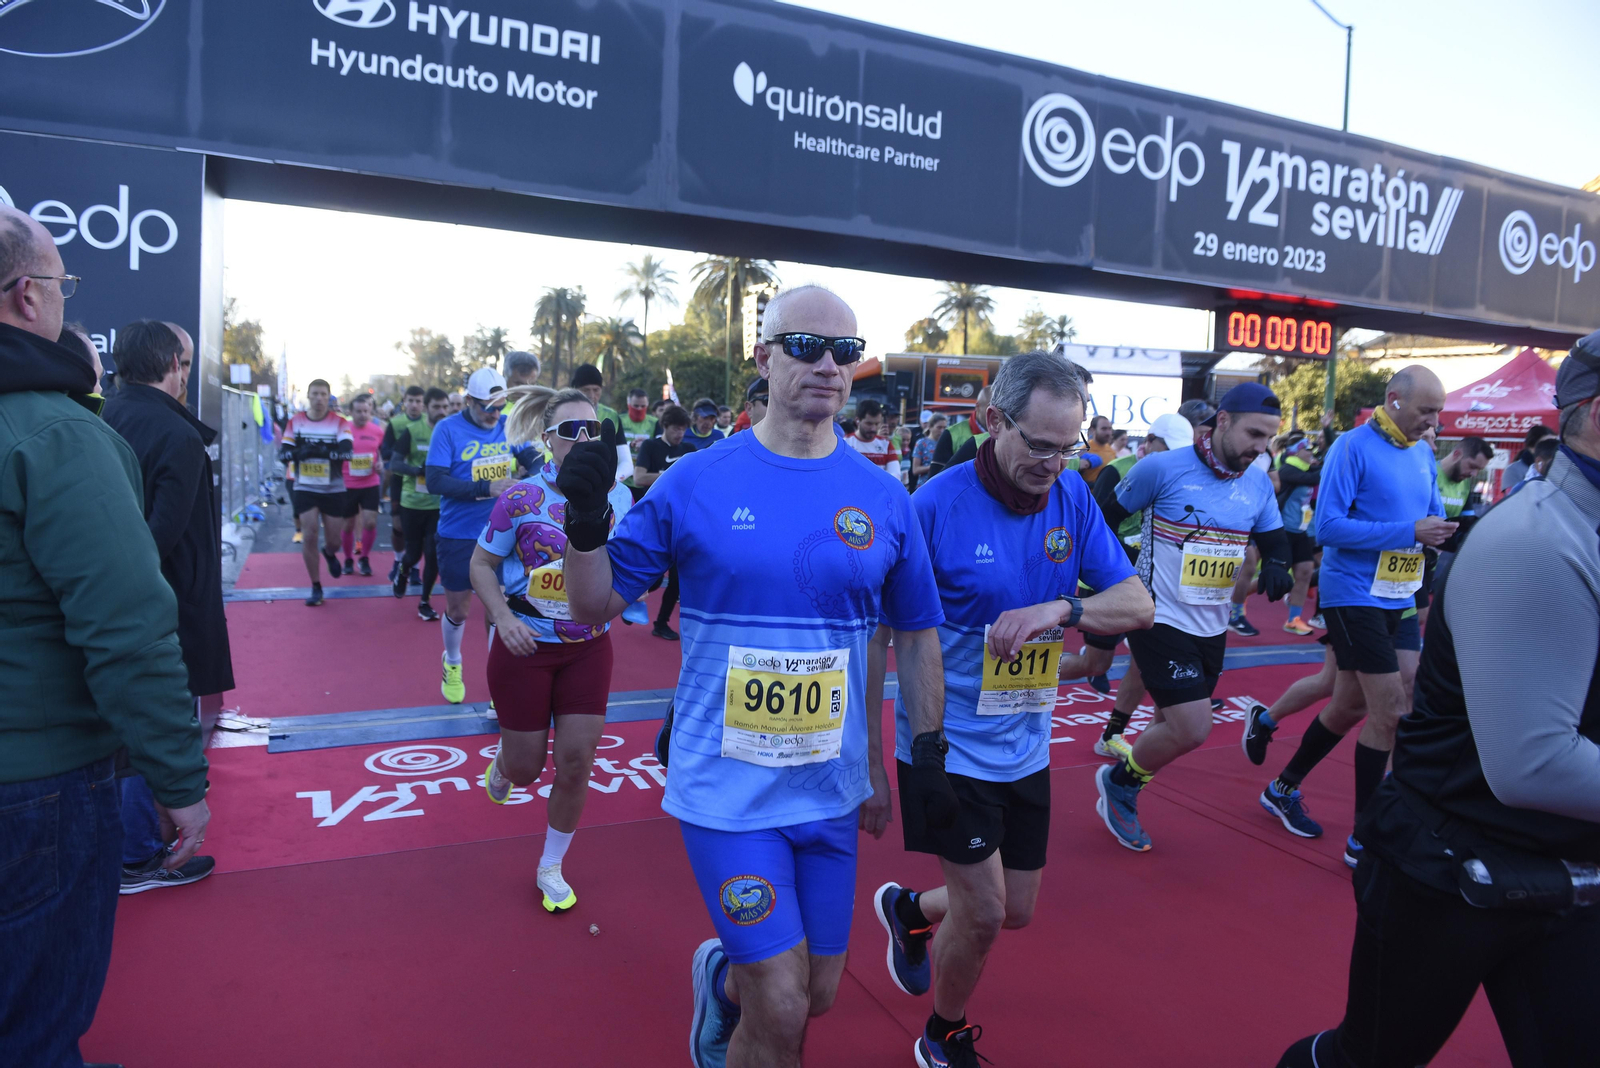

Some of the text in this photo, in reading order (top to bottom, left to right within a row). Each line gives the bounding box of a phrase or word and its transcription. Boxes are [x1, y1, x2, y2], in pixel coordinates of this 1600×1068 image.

[408, 1, 601, 65] HYUNDAI
[311, 38, 599, 110] Hyundauto Motor
[794, 131, 940, 172] Healthcare Partner
[1101, 115, 1206, 202] edp
[29, 184, 179, 271] edp
[1310, 200, 1430, 255] sevilla
[1193, 231, 1327, 273] 29 enero 2023
[1540, 223, 1597, 284] edp
[475, 465, 507, 480] 10306
[731, 523, 755, 531] mobel
[1189, 558, 1235, 578] 10110
[1388, 556, 1419, 573] 8765
[758, 656, 782, 671] edp
[994, 648, 1050, 676] 7811
[744, 678, 821, 716] 9610
[734, 720, 759, 730] Ramón
[761, 723, 787, 732] Manuel
[784, 734, 804, 747] edp
[757, 750, 774, 758] HOKA
